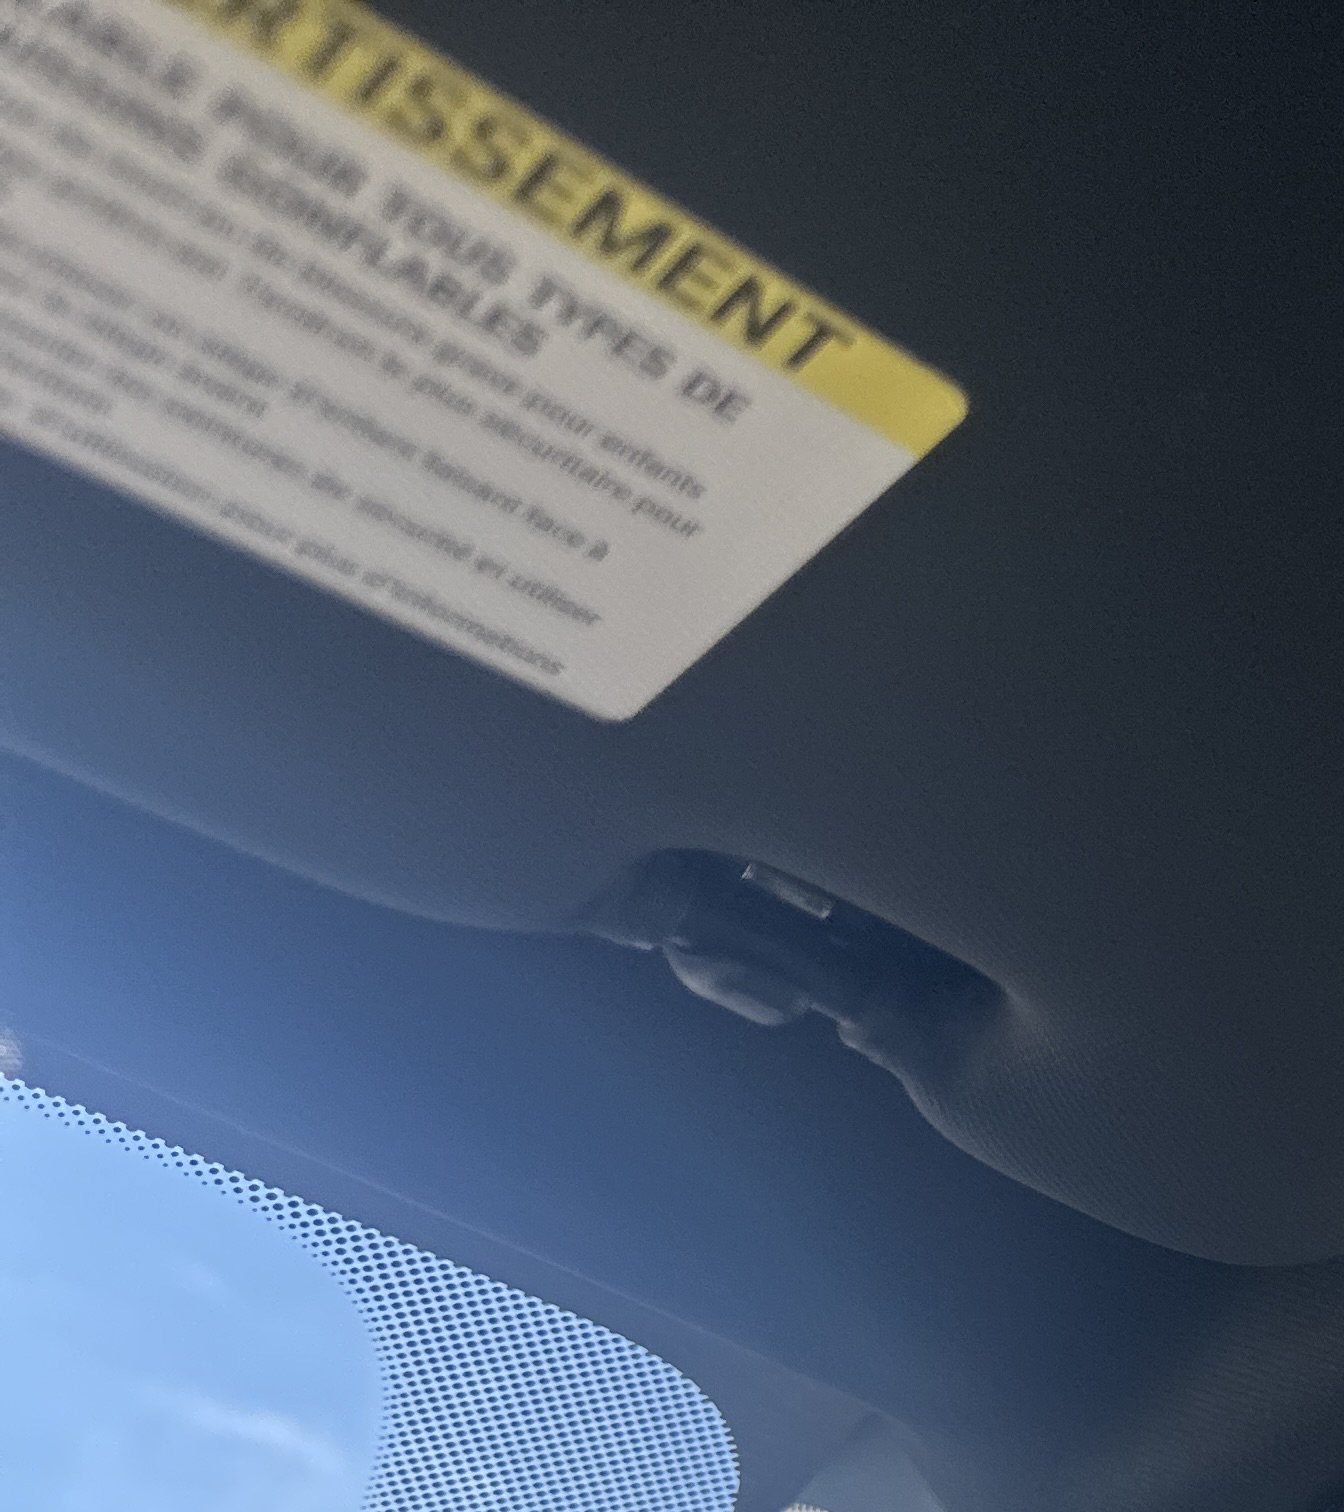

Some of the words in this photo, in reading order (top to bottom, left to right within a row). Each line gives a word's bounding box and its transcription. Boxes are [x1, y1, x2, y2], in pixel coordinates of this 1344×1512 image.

[208, 84, 367, 197] POUR
[379, 184, 514, 287] TOUS
[528, 274, 678, 381] TYPES
[677, 370, 753, 426] DE
